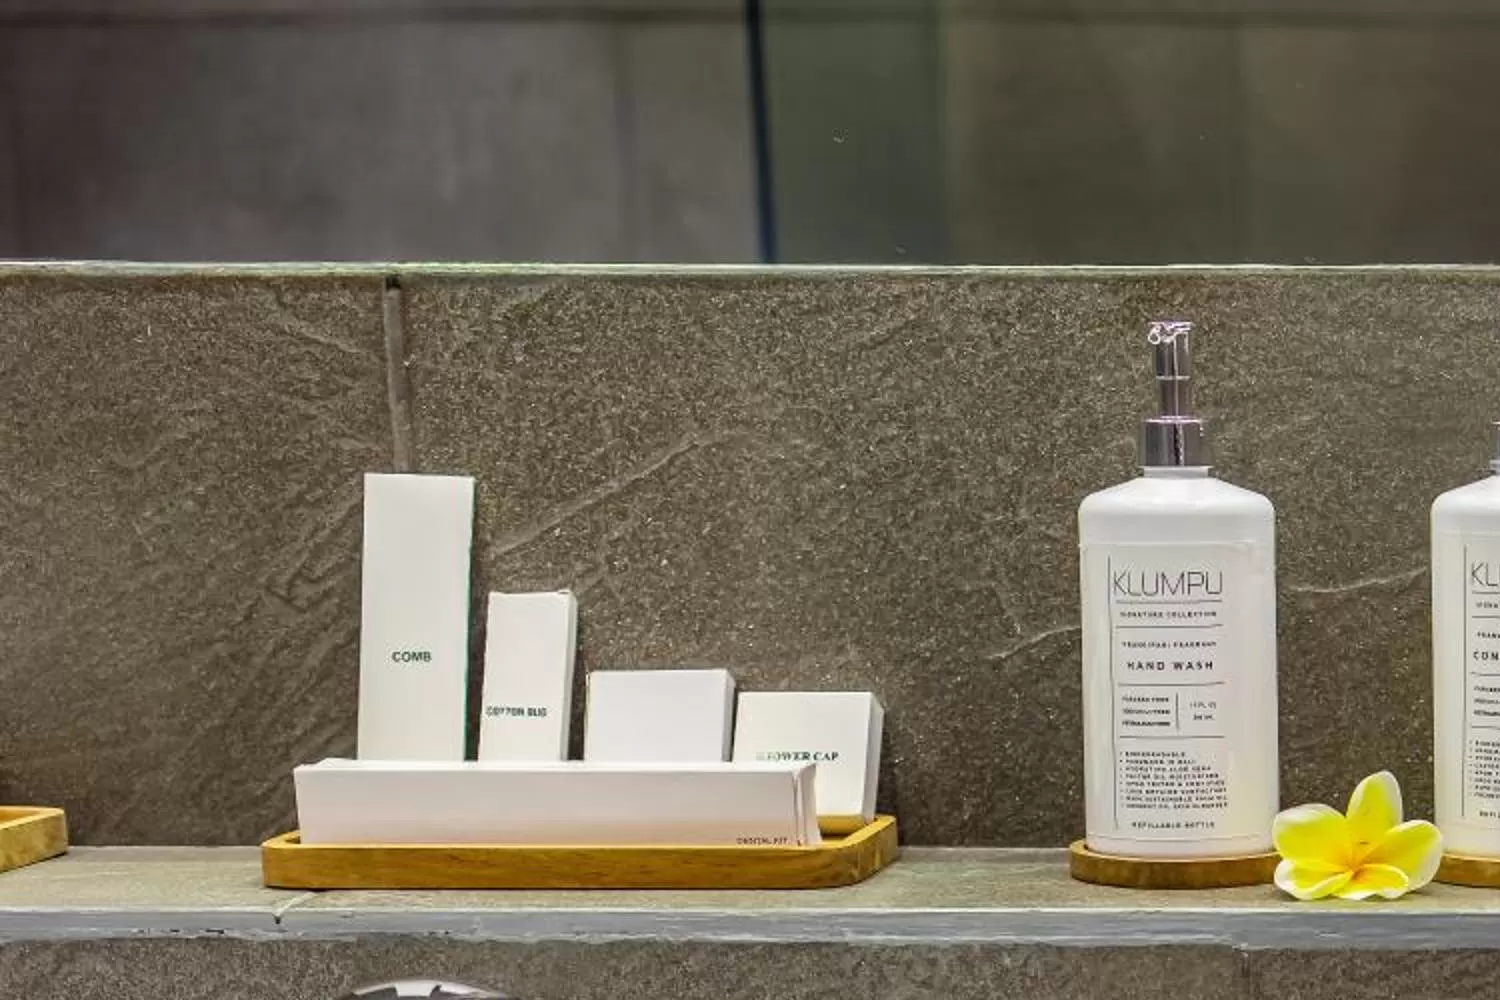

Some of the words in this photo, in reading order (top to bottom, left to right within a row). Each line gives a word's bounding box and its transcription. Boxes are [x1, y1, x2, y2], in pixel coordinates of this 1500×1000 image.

[1113, 570, 1222, 597] KLUMPU
[391, 651, 432, 663] COMB
[1127, 661, 1165, 671] HAND
[1171, 660, 1213, 671] WASH
[486, 706, 525, 718] COTTON
[813, 751, 839, 761] CAP
